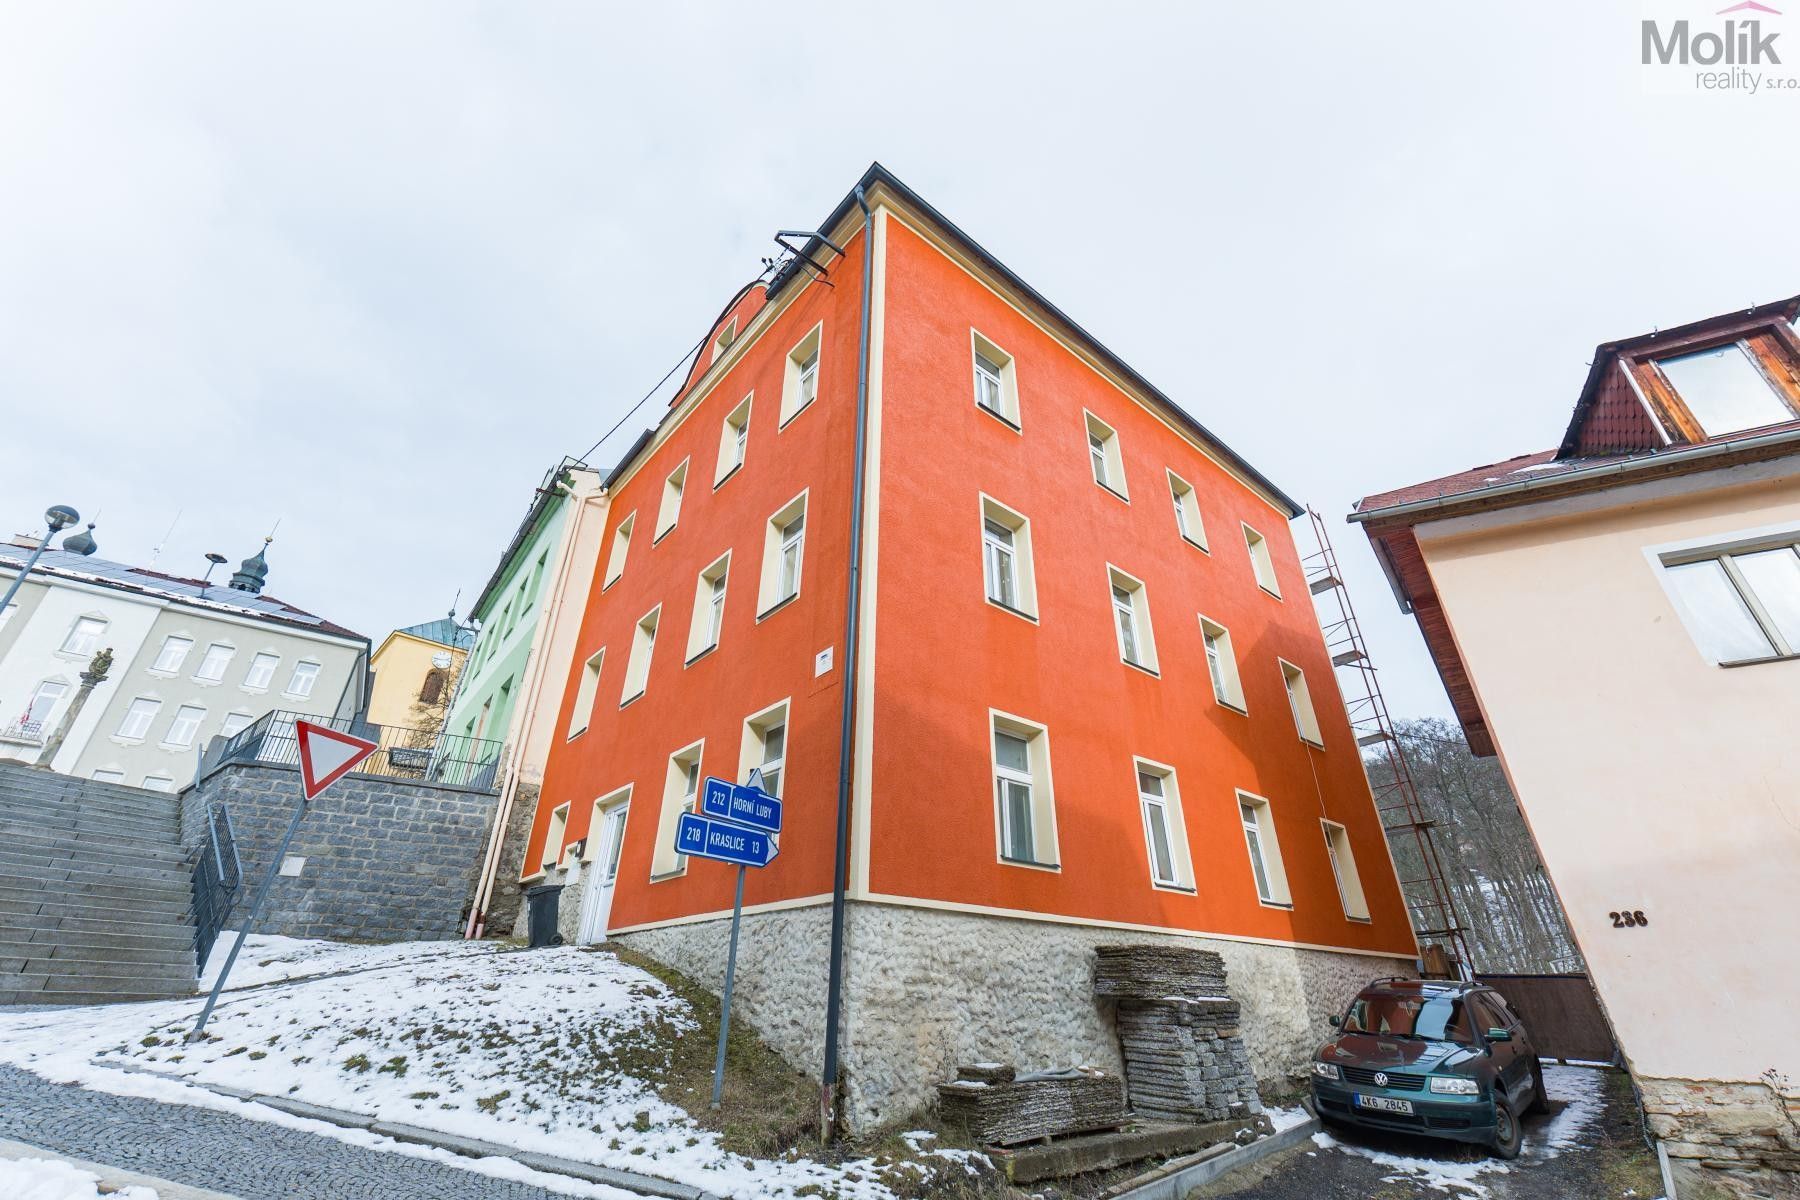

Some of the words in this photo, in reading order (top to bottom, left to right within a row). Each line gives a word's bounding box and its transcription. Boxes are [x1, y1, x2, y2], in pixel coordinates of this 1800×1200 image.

[711, 790, 726, 806] 212
[733, 797, 755, 815] HORNÍ
[756, 804, 772, 819] LUBY
[686, 827, 701, 842] 218
[710, 832, 745, 851] KRASLICE
[752, 841, 760, 854] 13
[1384, 1100, 1408, 1111] 2845
